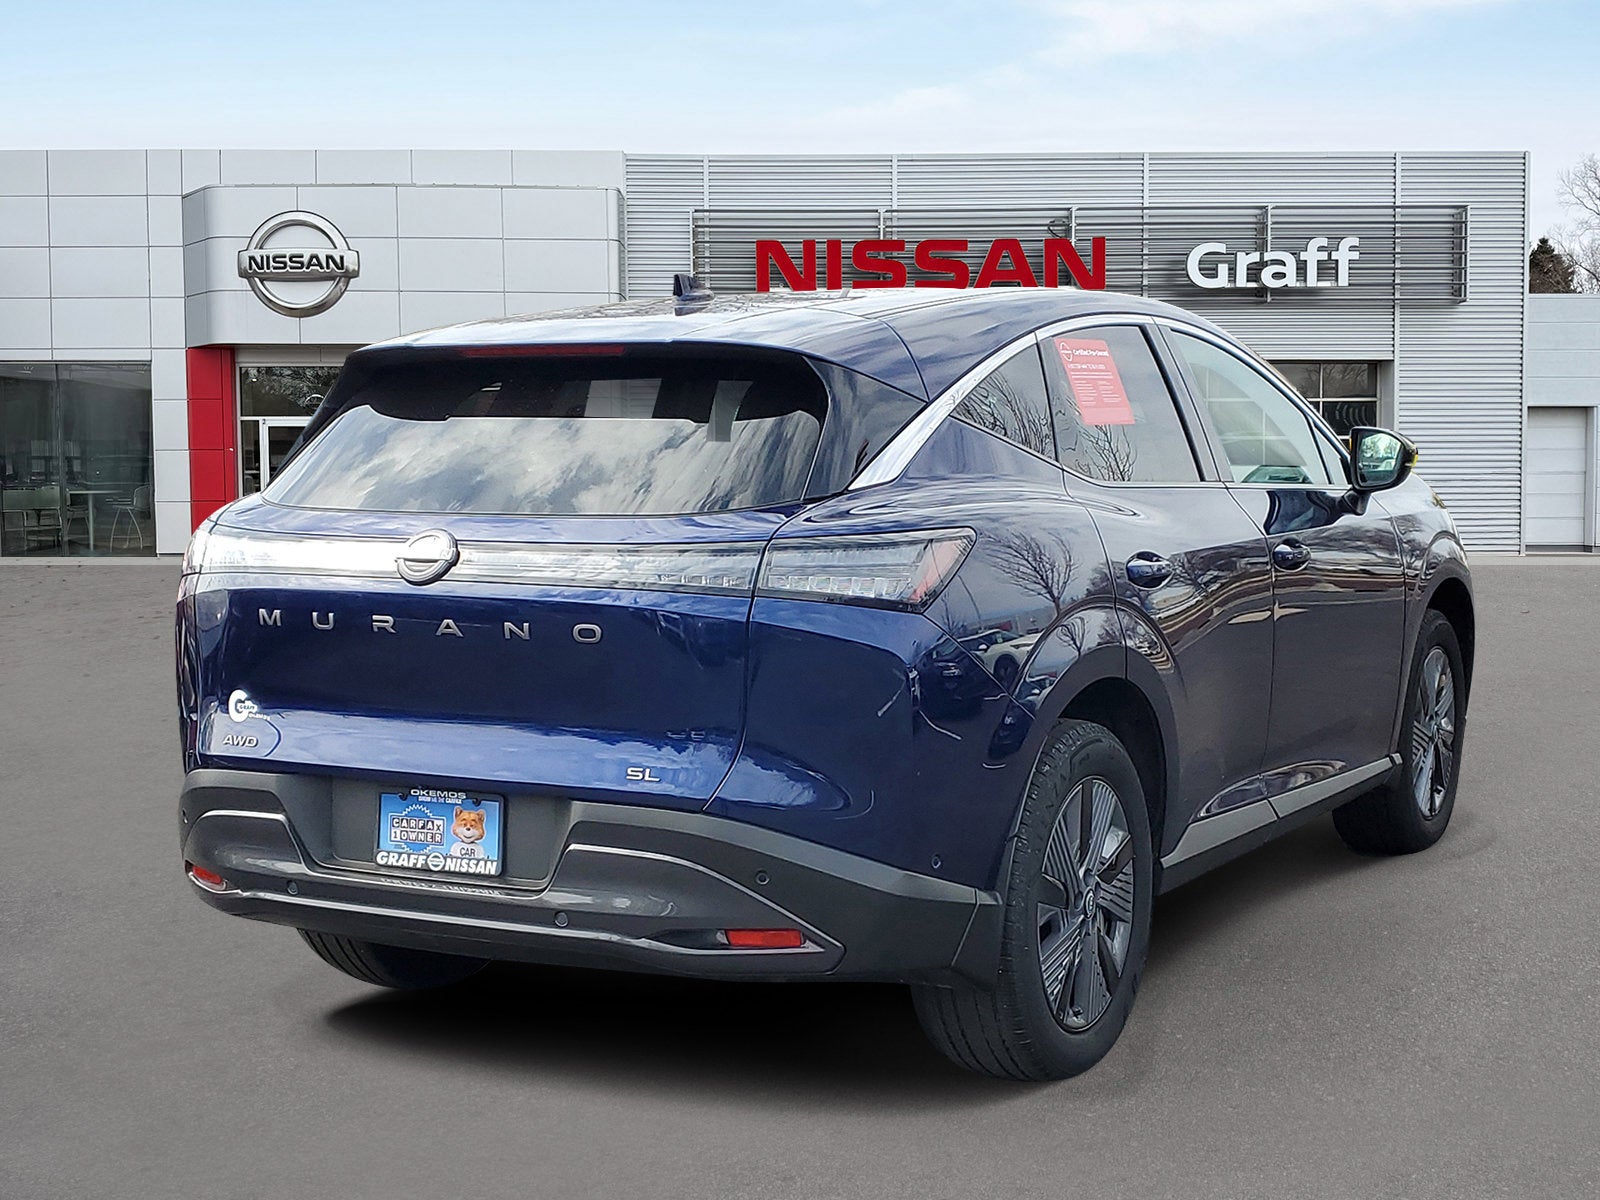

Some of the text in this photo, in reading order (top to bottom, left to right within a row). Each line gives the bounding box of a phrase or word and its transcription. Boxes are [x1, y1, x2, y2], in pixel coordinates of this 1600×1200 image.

[247, 254, 345, 271] NISSAN
[756, 236, 1106, 292] NISSAN
[1186, 237, 1360, 289] Graff
[257, 608, 603, 644] MURANO
[222, 734, 259, 748] AWD
[626, 766, 661, 782] SL
[410, 788, 467, 800] OKEMOS
[392, 817, 442, 832] CARFAX
[459, 846, 476, 858] CAR
[376, 851, 498, 876] GRAFF NISSAN
